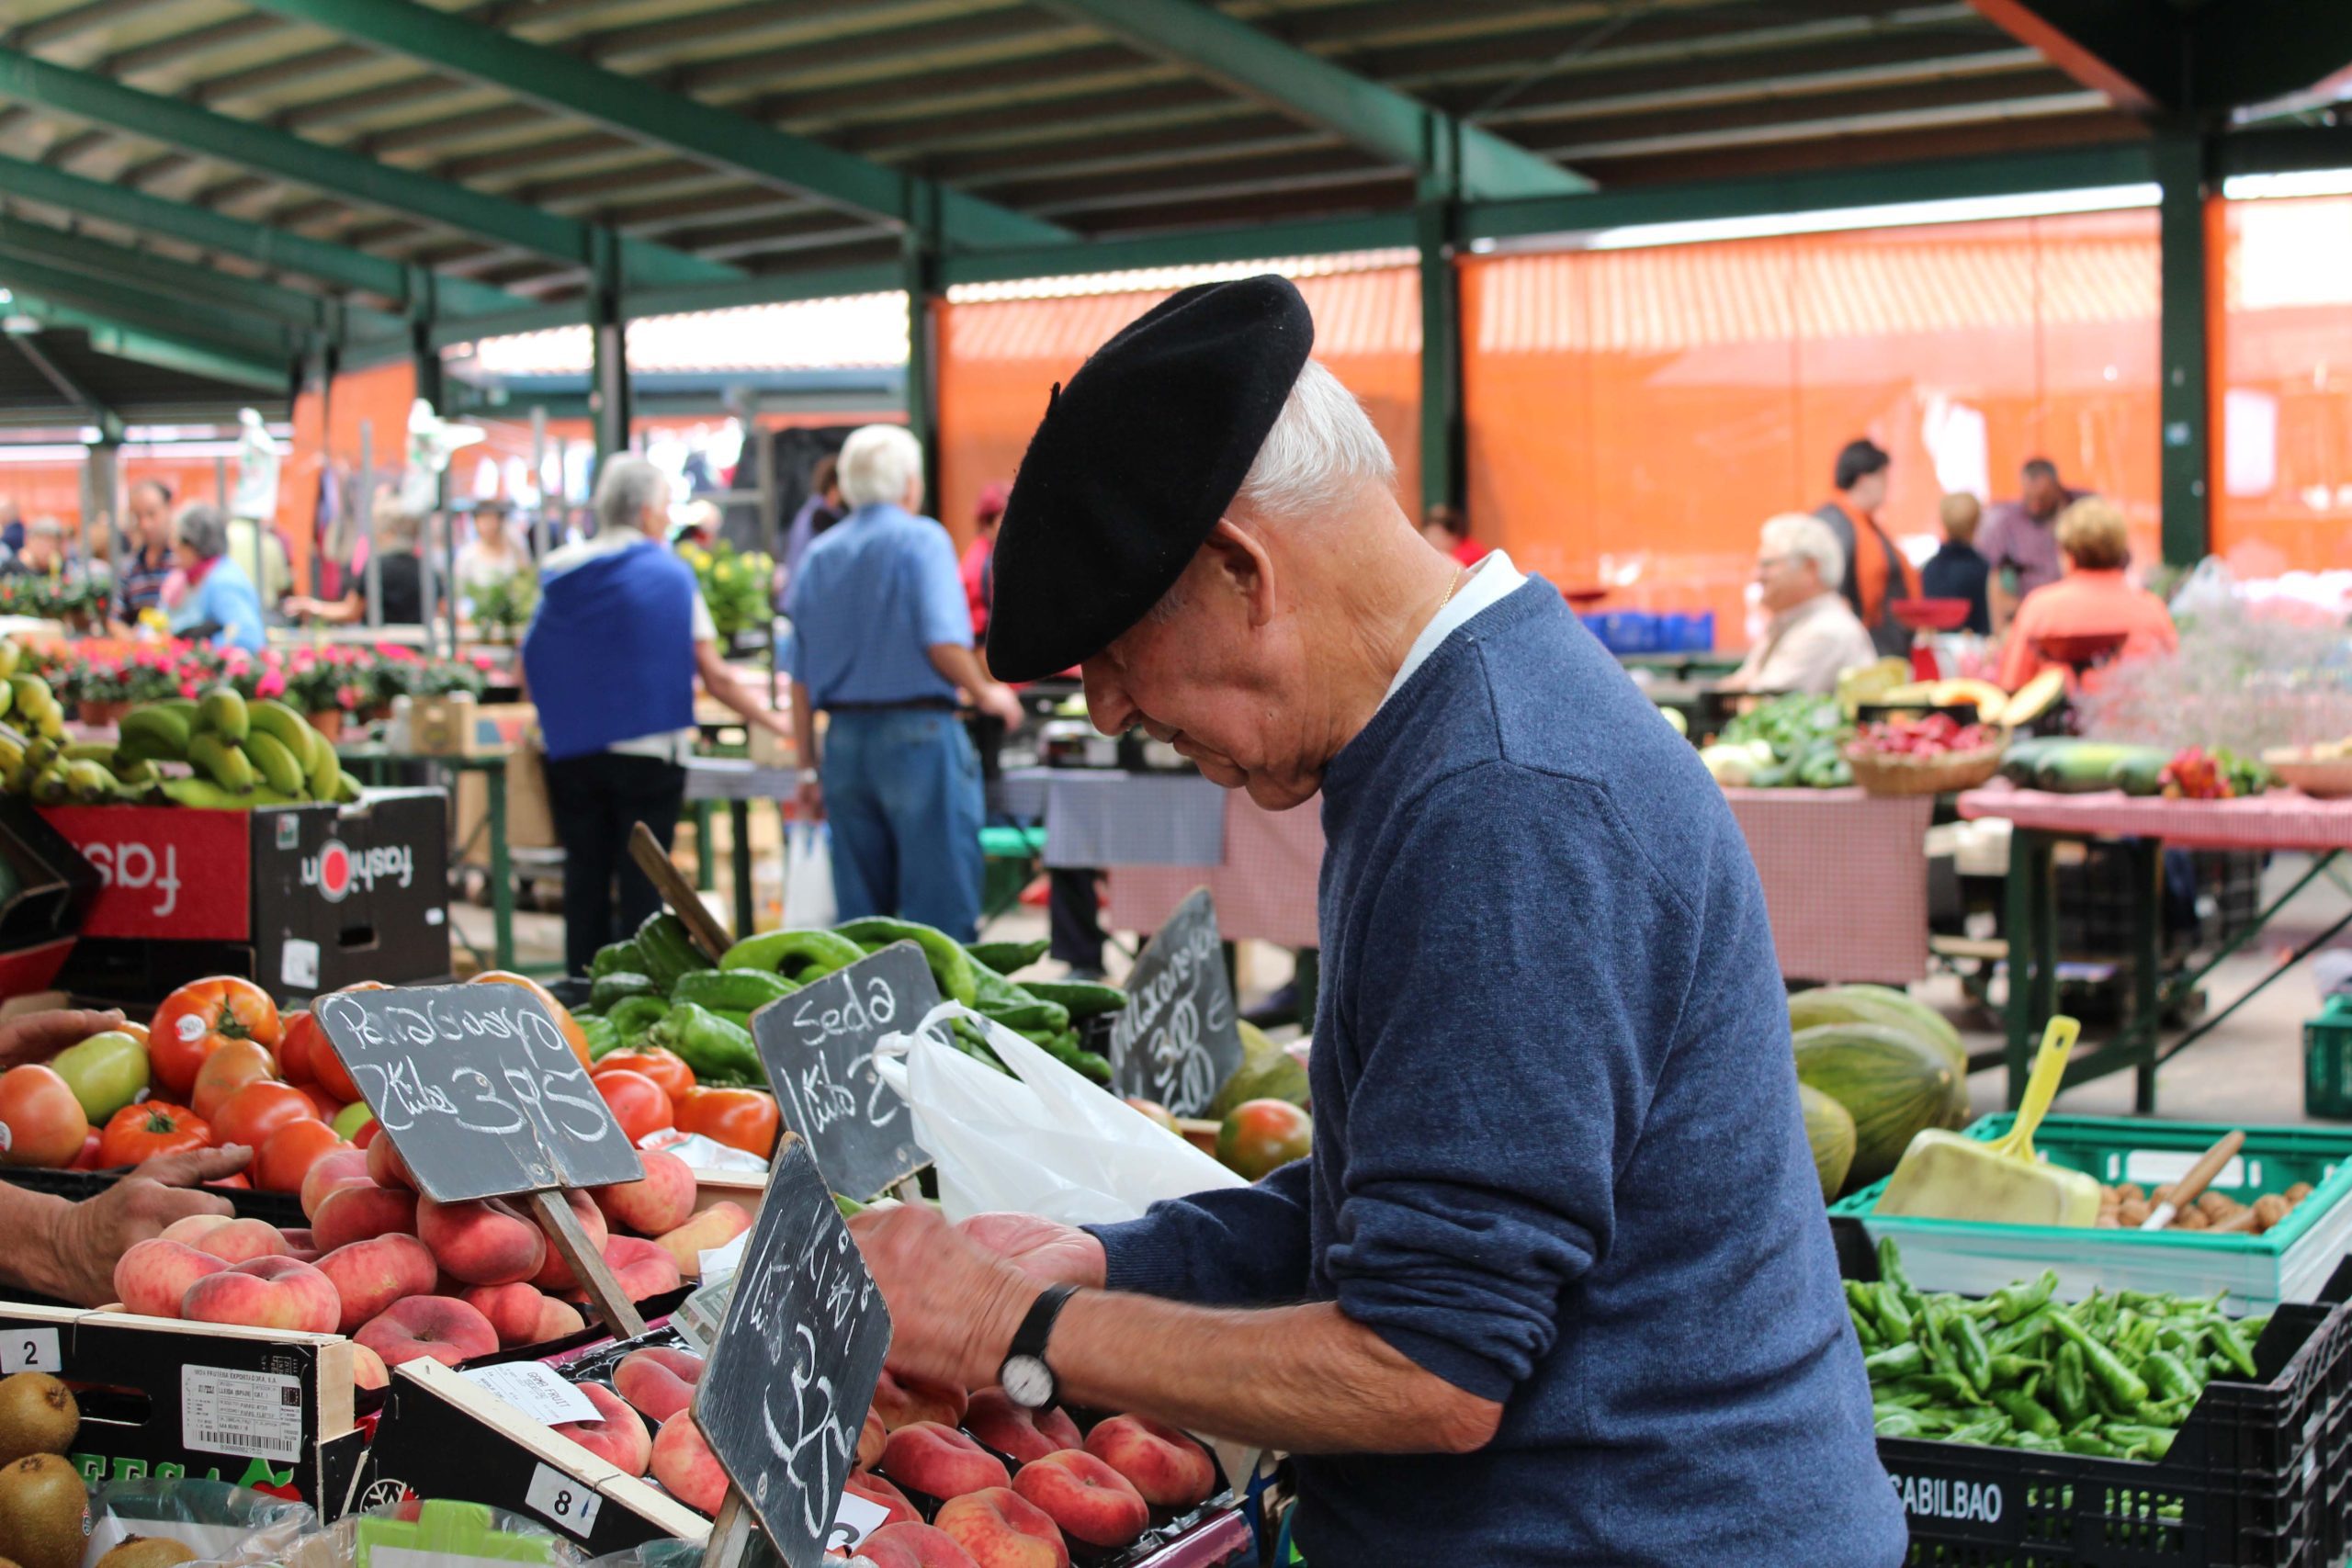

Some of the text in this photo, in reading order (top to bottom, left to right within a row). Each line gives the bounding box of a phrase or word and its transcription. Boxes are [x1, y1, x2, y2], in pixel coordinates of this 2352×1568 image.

[793, 971, 896, 1046] Seda
[24, 1341, 38, 1365] 2
[547, 1388, 571, 1409] FRUIT
[554, 1490, 571, 1515] 8
